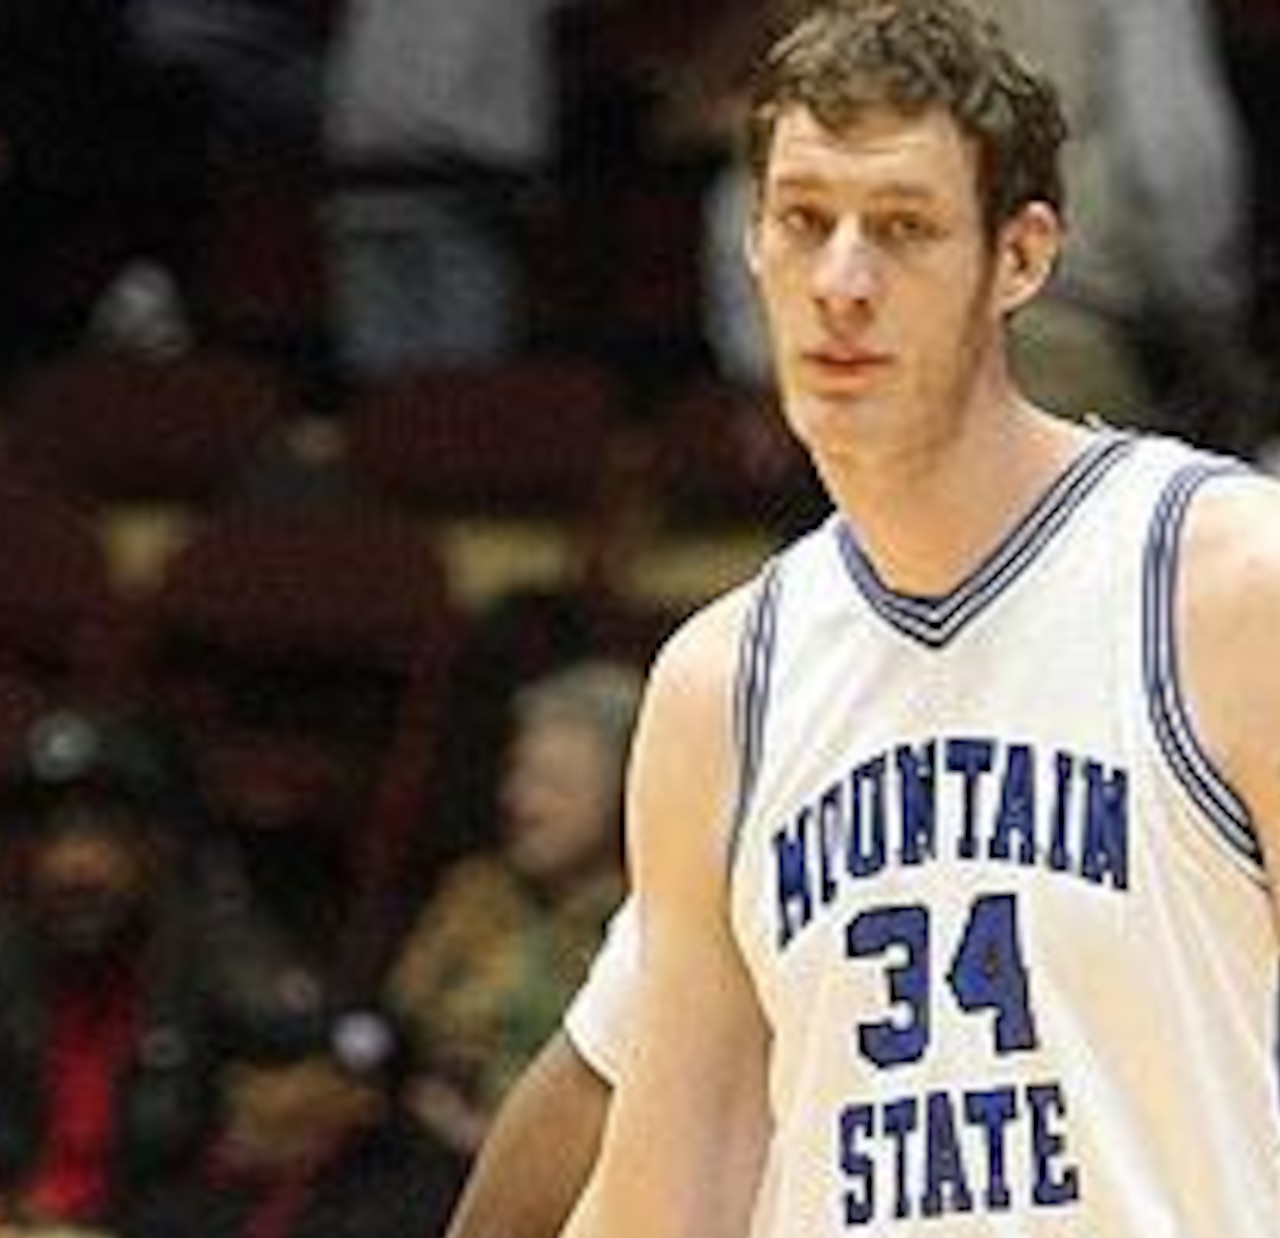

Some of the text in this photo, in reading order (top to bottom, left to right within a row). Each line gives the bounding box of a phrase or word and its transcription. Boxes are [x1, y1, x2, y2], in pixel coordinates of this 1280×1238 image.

[772, 736, 1129, 950] MOUNTAIN
[843, 892, 1040, 1070] 34
[838, 1083, 1080, 1226] STATE
